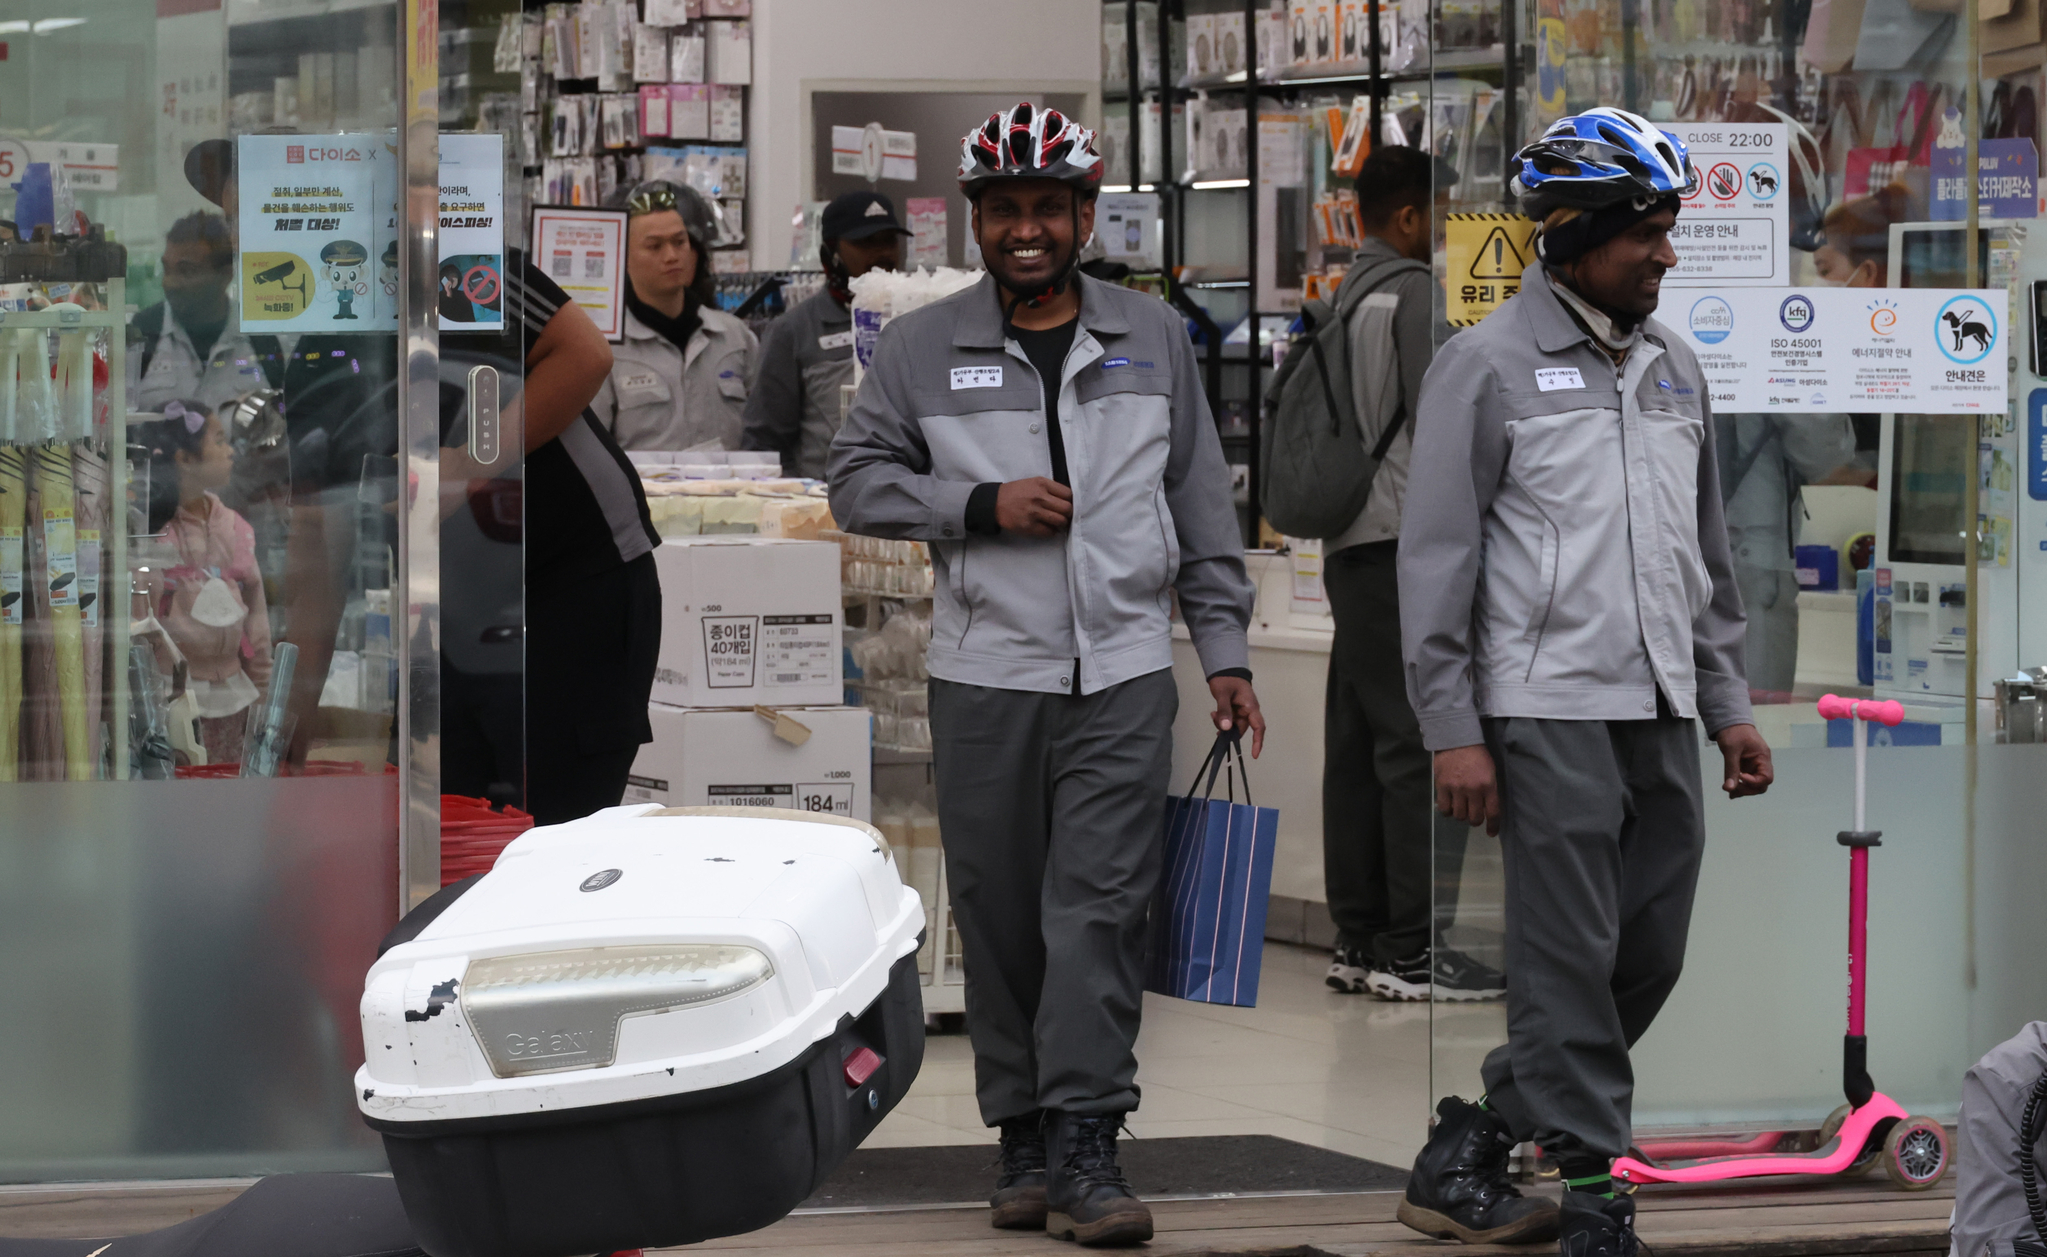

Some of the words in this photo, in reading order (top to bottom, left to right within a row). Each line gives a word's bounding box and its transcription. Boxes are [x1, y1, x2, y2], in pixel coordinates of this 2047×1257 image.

[1688, 132, 1723, 143] CLOSE
[1729, 133, 1773, 147] 22:00
[309, 147, 361, 161] 다이소
[328, 202, 355, 213] 행위도
[450, 201, 486, 213] 요구하면
[274, 218, 304, 231] 처벌
[306, 217, 341, 231] 대상!
[438, 217, 493, 229] 이스피싱!
[1693, 224, 1715, 238] 운영
[1716, 224, 1739, 238] 안내
[1460, 285, 1495, 304] 유리
[1693, 315, 1730, 326] 소비자중심
[1788, 306, 1807, 321] kfq
[1770, 338, 1789, 348] ISO
[1790, 338, 1822, 348] 45001
[1851, 347, 1893, 359] 에너지절약
[1895, 347, 1912, 359] 안내
[1798, 378, 1828, 386] 아성다이소
[1945, 369, 1987, 383] 안내견은
[482, 408, 490, 450] PUSH
[710, 624, 751, 641] 종이컵
[710, 640, 751, 655] 40개입
[803, 794, 834, 812] 184
[835, 799, 849, 811] ml
[505, 1029, 594, 1056] Galaxy
